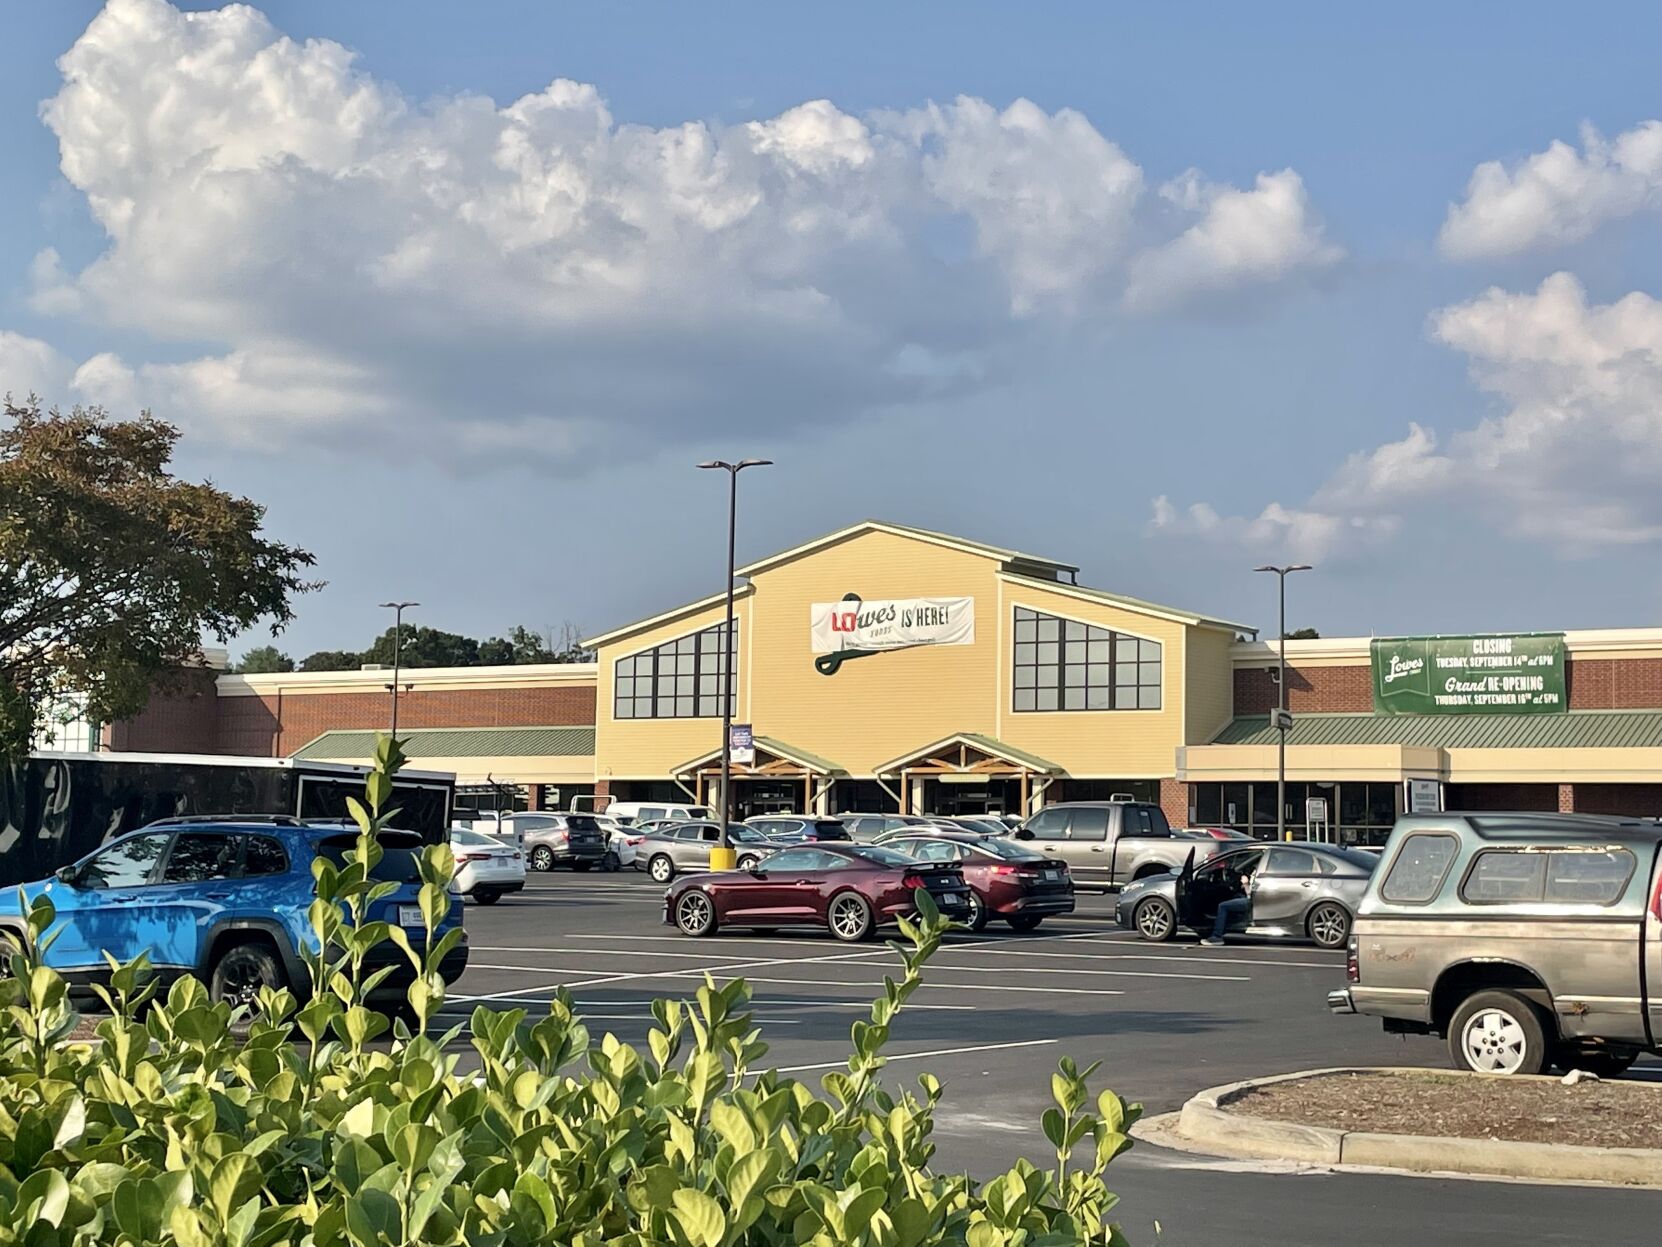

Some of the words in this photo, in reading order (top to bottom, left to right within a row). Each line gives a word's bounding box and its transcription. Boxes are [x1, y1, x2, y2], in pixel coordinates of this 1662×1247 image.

[901, 609, 913, 628] IS
[916, 605, 949, 627] HERE!
[1473, 639, 1512, 654] CLOSING
[1384, 655, 1424, 683] Lowes
[1436, 656, 1469, 668] TUESDAY,
[1470, 656, 1512, 668] SEPTEMBER
[1445, 676, 1487, 693] Grand
[1487, 675, 1543, 692] RE-OPENING
[1435, 695, 1473, 705] THURSDAY,
[1474, 694, 1516, 705] SEPTEMBER
[1532, 694, 1543, 704] at
